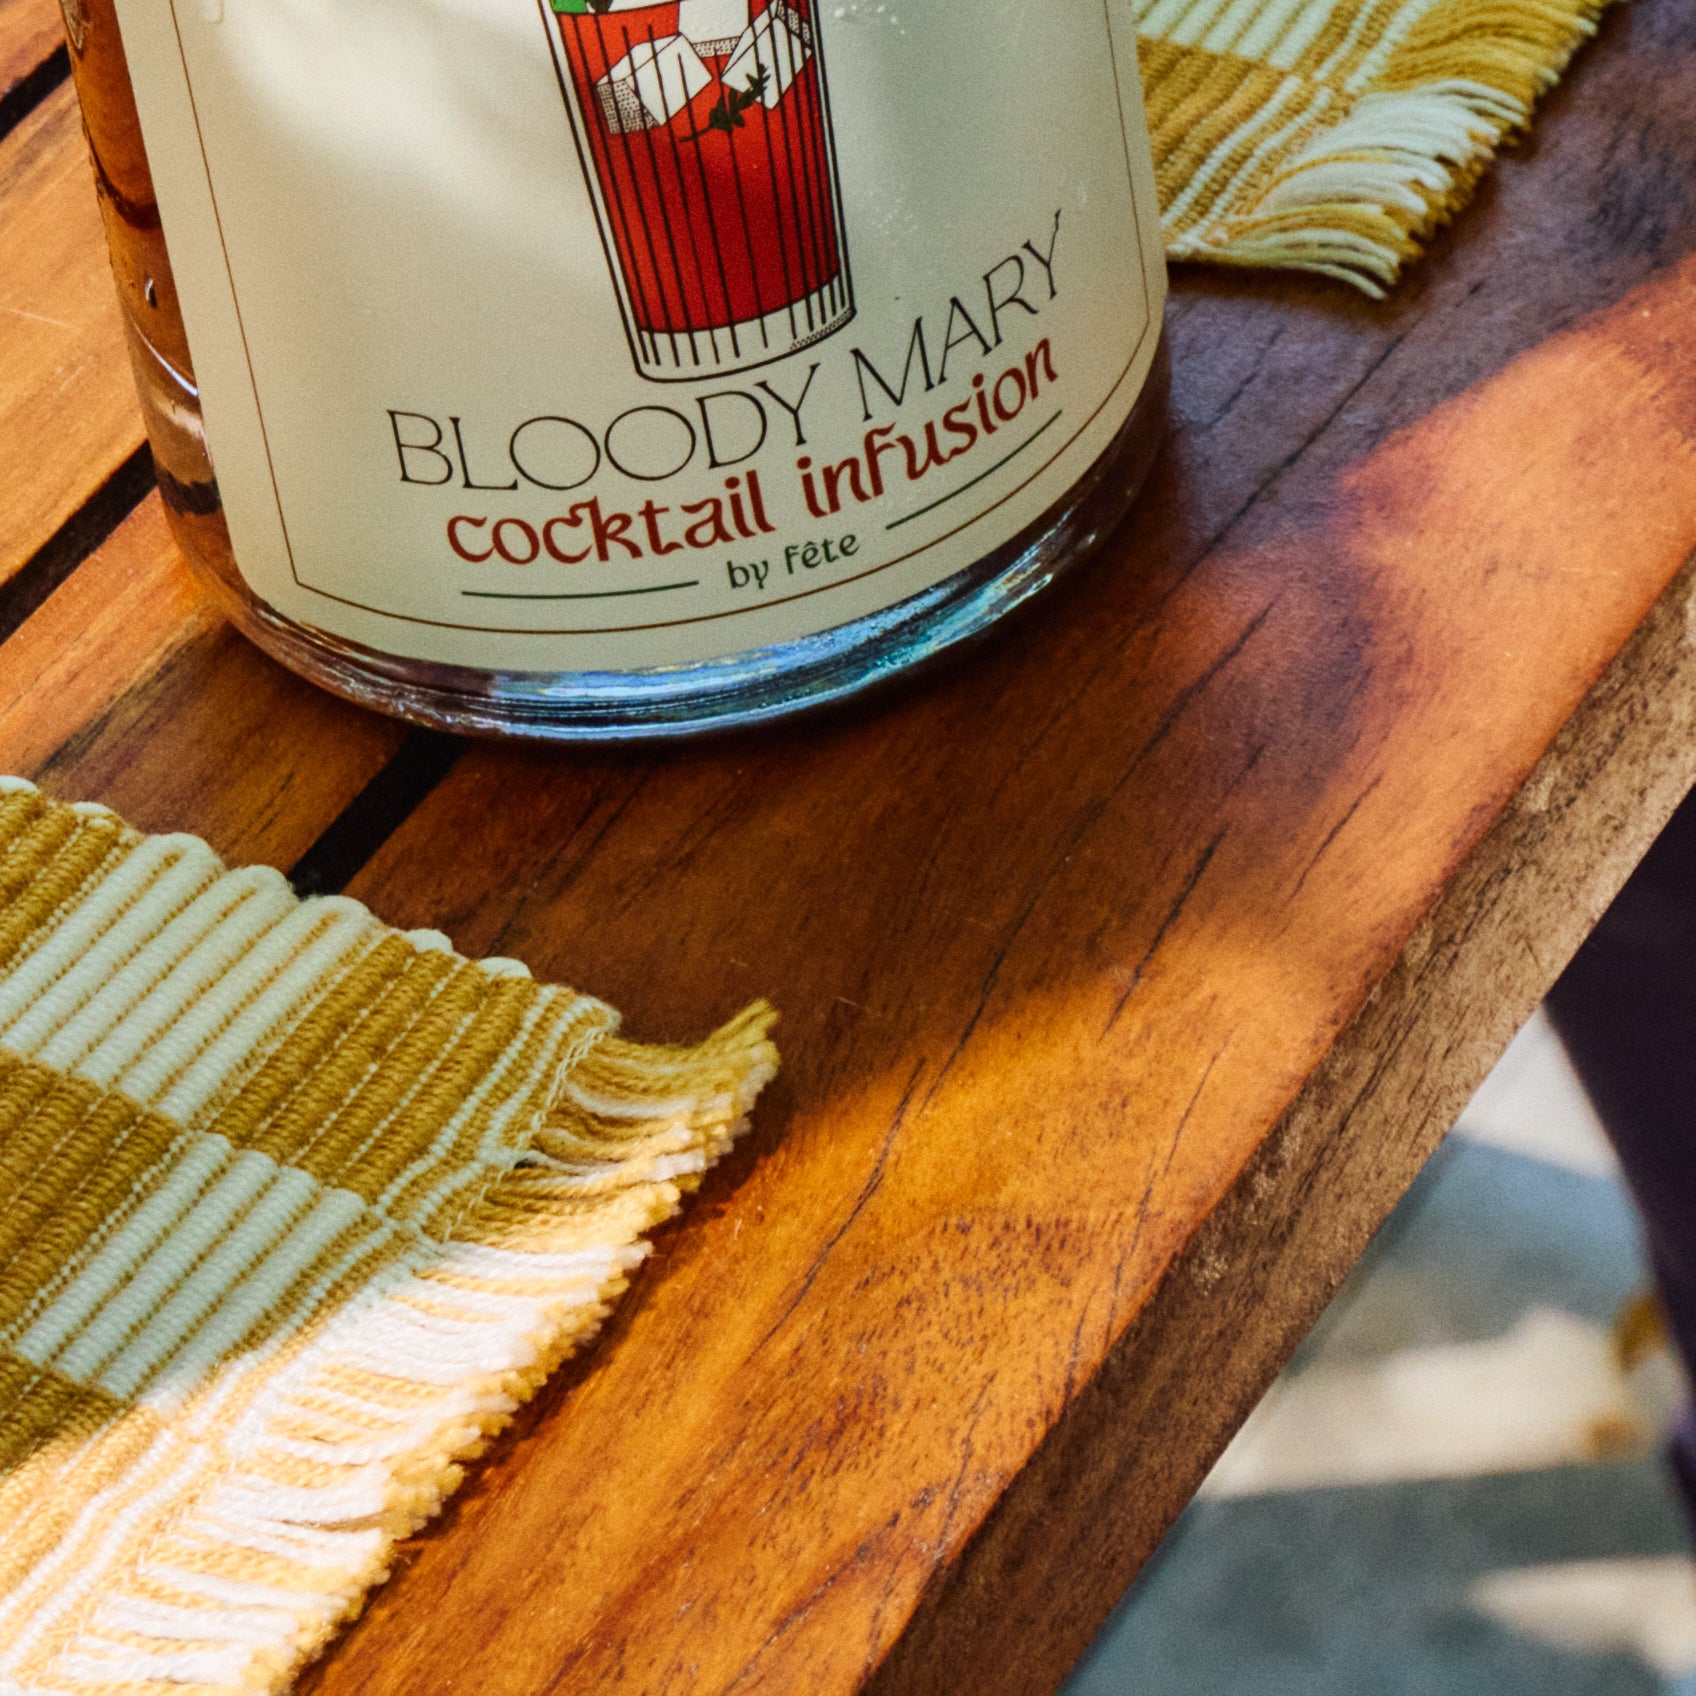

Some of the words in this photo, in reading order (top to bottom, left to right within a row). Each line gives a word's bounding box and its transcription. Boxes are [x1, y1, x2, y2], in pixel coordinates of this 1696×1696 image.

[385, 362, 822, 492] BLOODY
[849, 208, 1063, 423] MARY
[446, 468, 776, 567] cocktail
[796, 336, 1060, 520] infusion
[726, 560, 769, 590] by
[783, 533, 860, 575] fête
